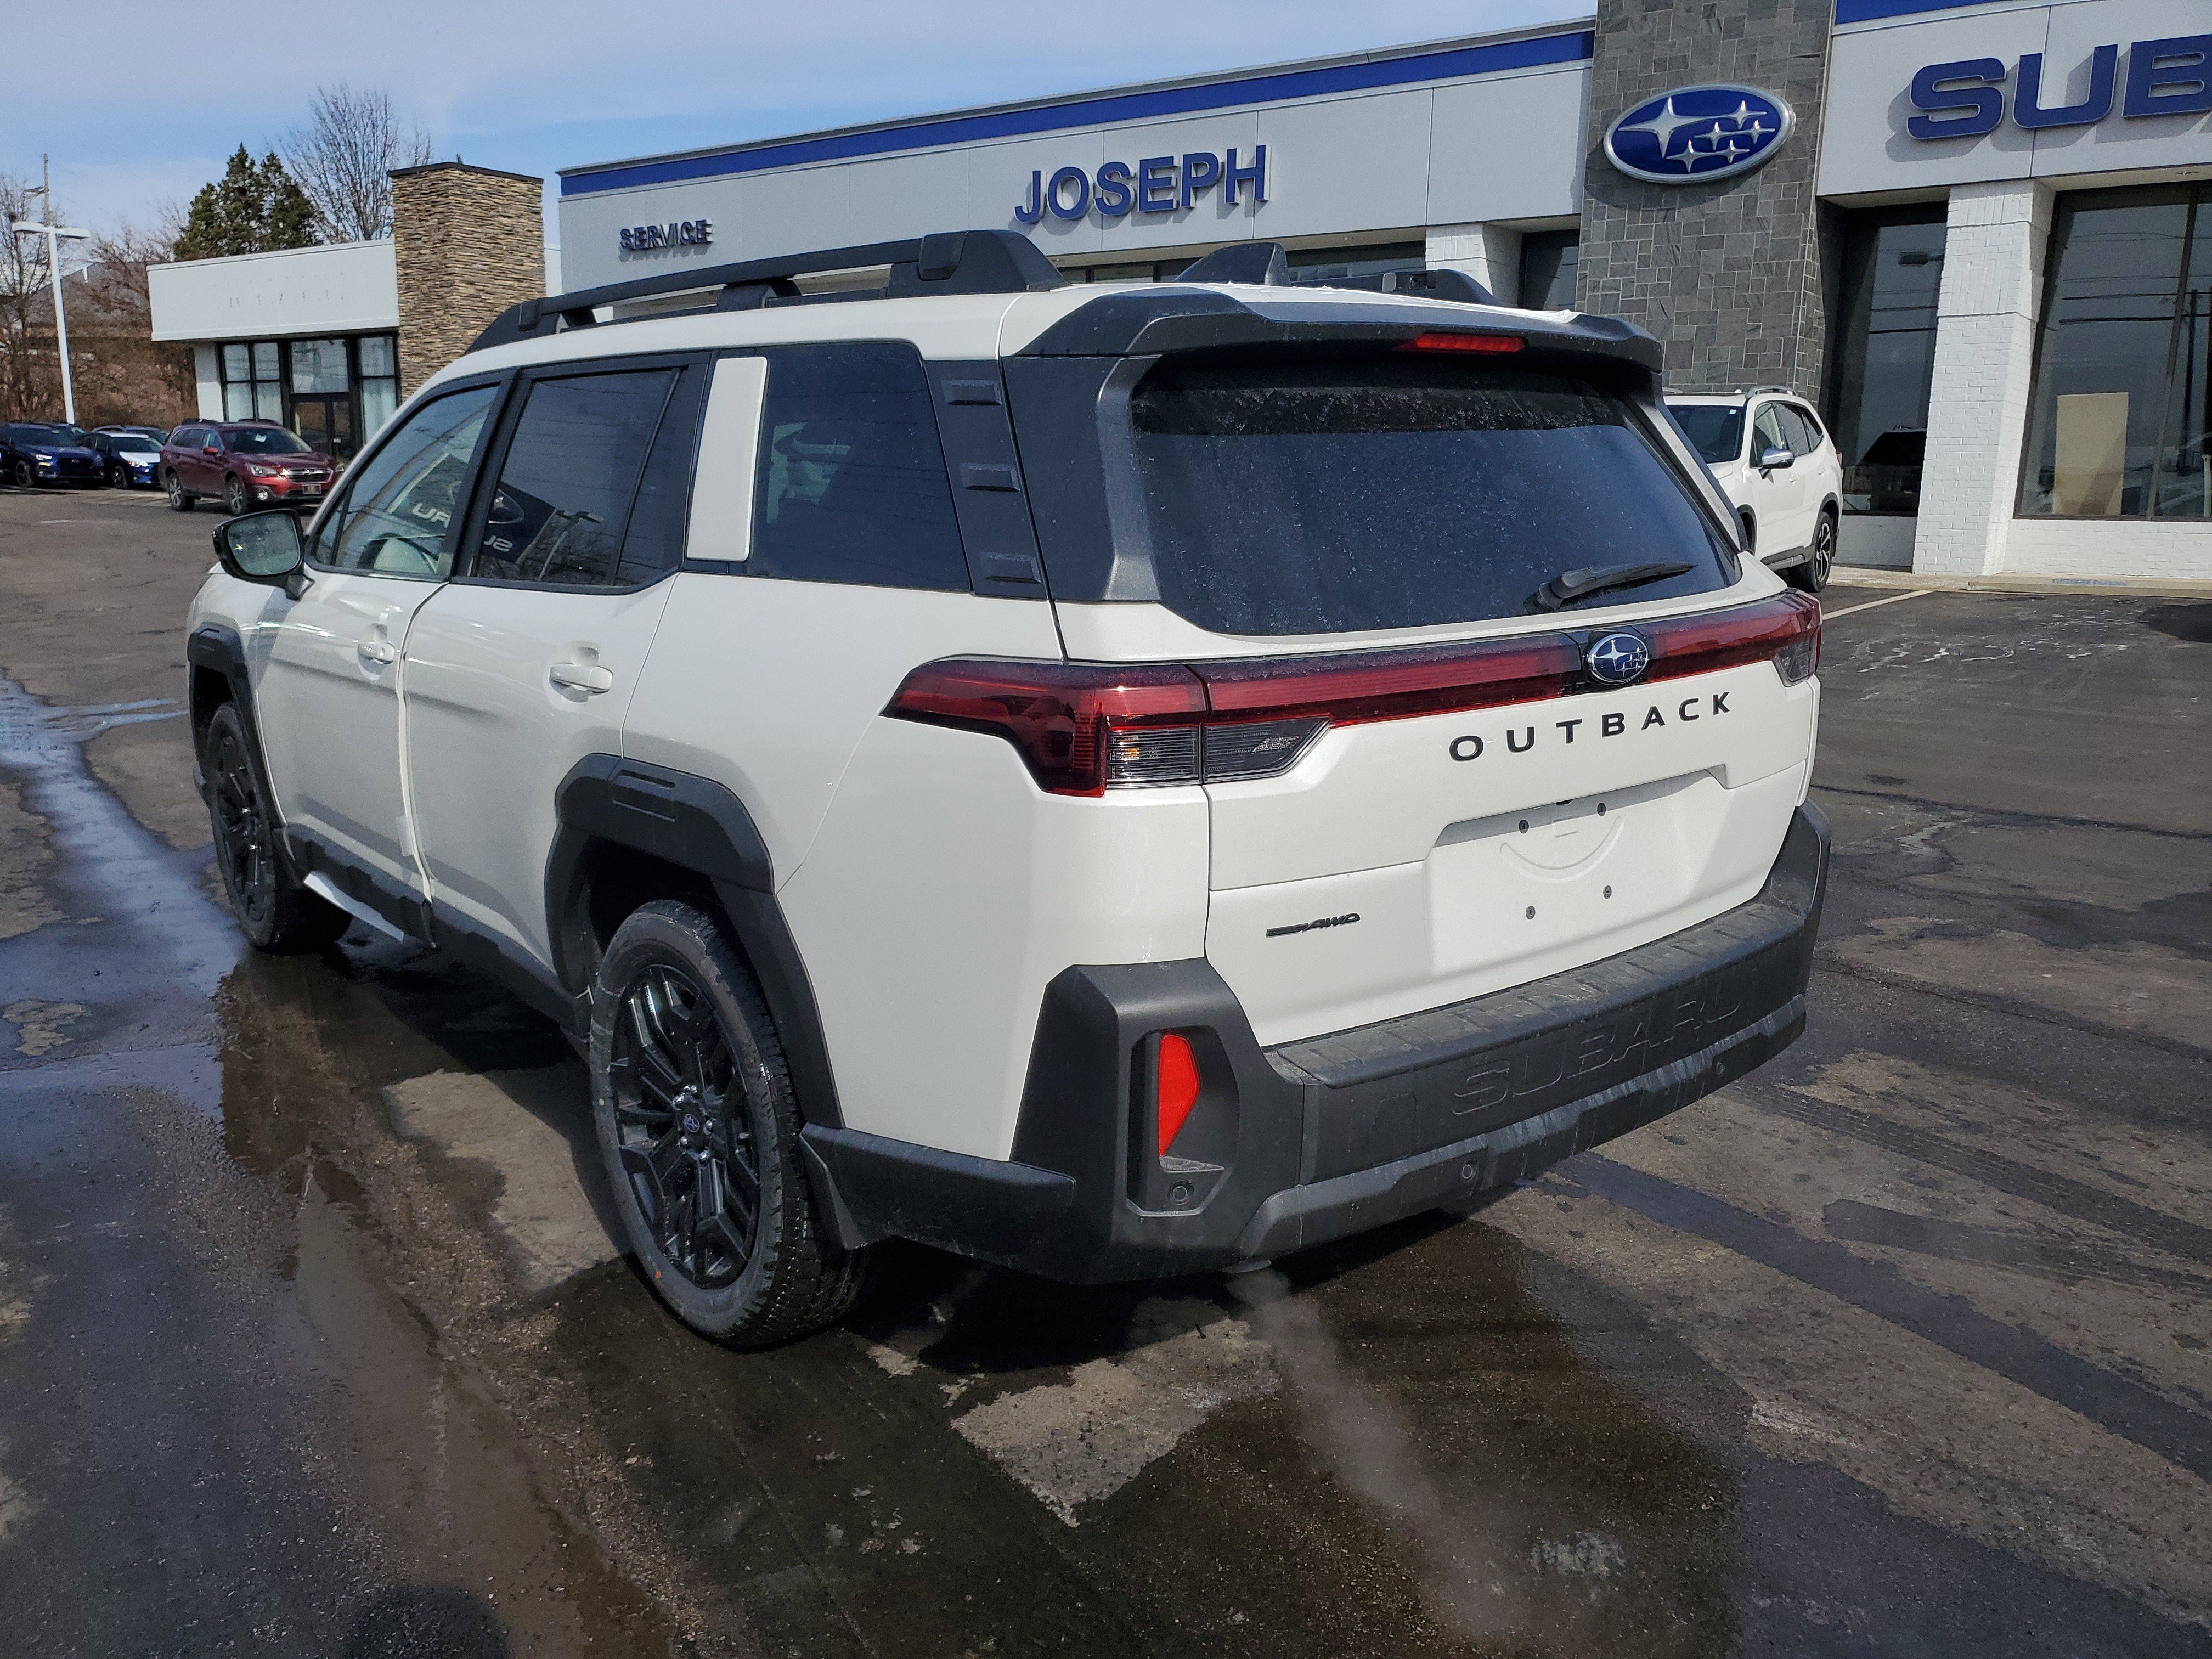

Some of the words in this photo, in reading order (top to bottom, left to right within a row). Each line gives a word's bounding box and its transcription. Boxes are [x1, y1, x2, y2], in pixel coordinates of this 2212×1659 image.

[1014, 144, 1271, 223] JOSEPH
[619, 219, 713, 250] SERVICE
[1449, 691, 1730, 761] OUTBACK
[1303, 912, 1361, 932] AWD
[1452, 979, 1742, 1116] SUBARU
